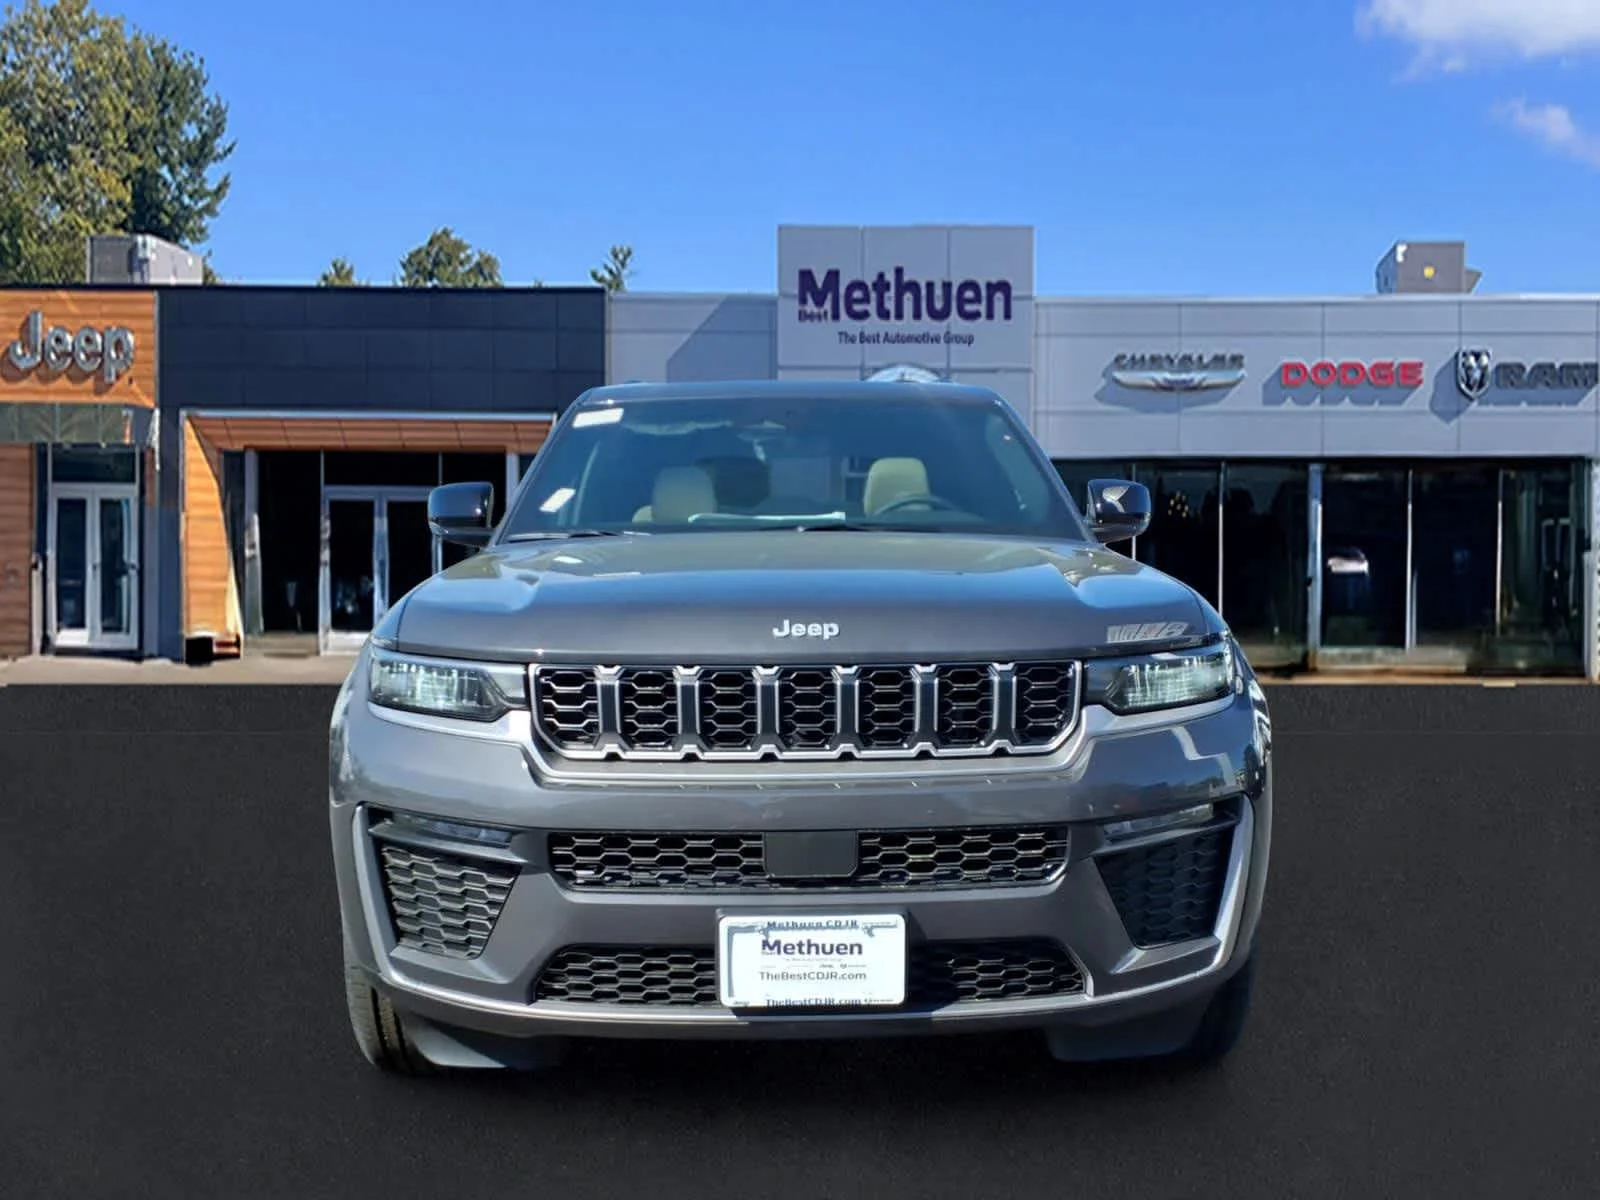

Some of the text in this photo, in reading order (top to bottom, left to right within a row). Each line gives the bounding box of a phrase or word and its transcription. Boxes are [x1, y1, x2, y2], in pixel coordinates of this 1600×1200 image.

[798, 266, 1012, 320] Methuen
[798, 309, 828, 323] Best
[9, 310, 134, 384] Jeep
[838, 331, 974, 346] The Best Automotive Group
[1114, 353, 1245, 370] CHRYSLER
[1281, 361, 1424, 386] DODGE
[1495, 362, 1599, 389] RAM
[772, 619, 840, 640] Jeep
[767, 920, 859, 930] Methuen CDJR
[761, 939, 863, 955] Methuen
[760, 971, 867, 981] TheBestCDJR.com
